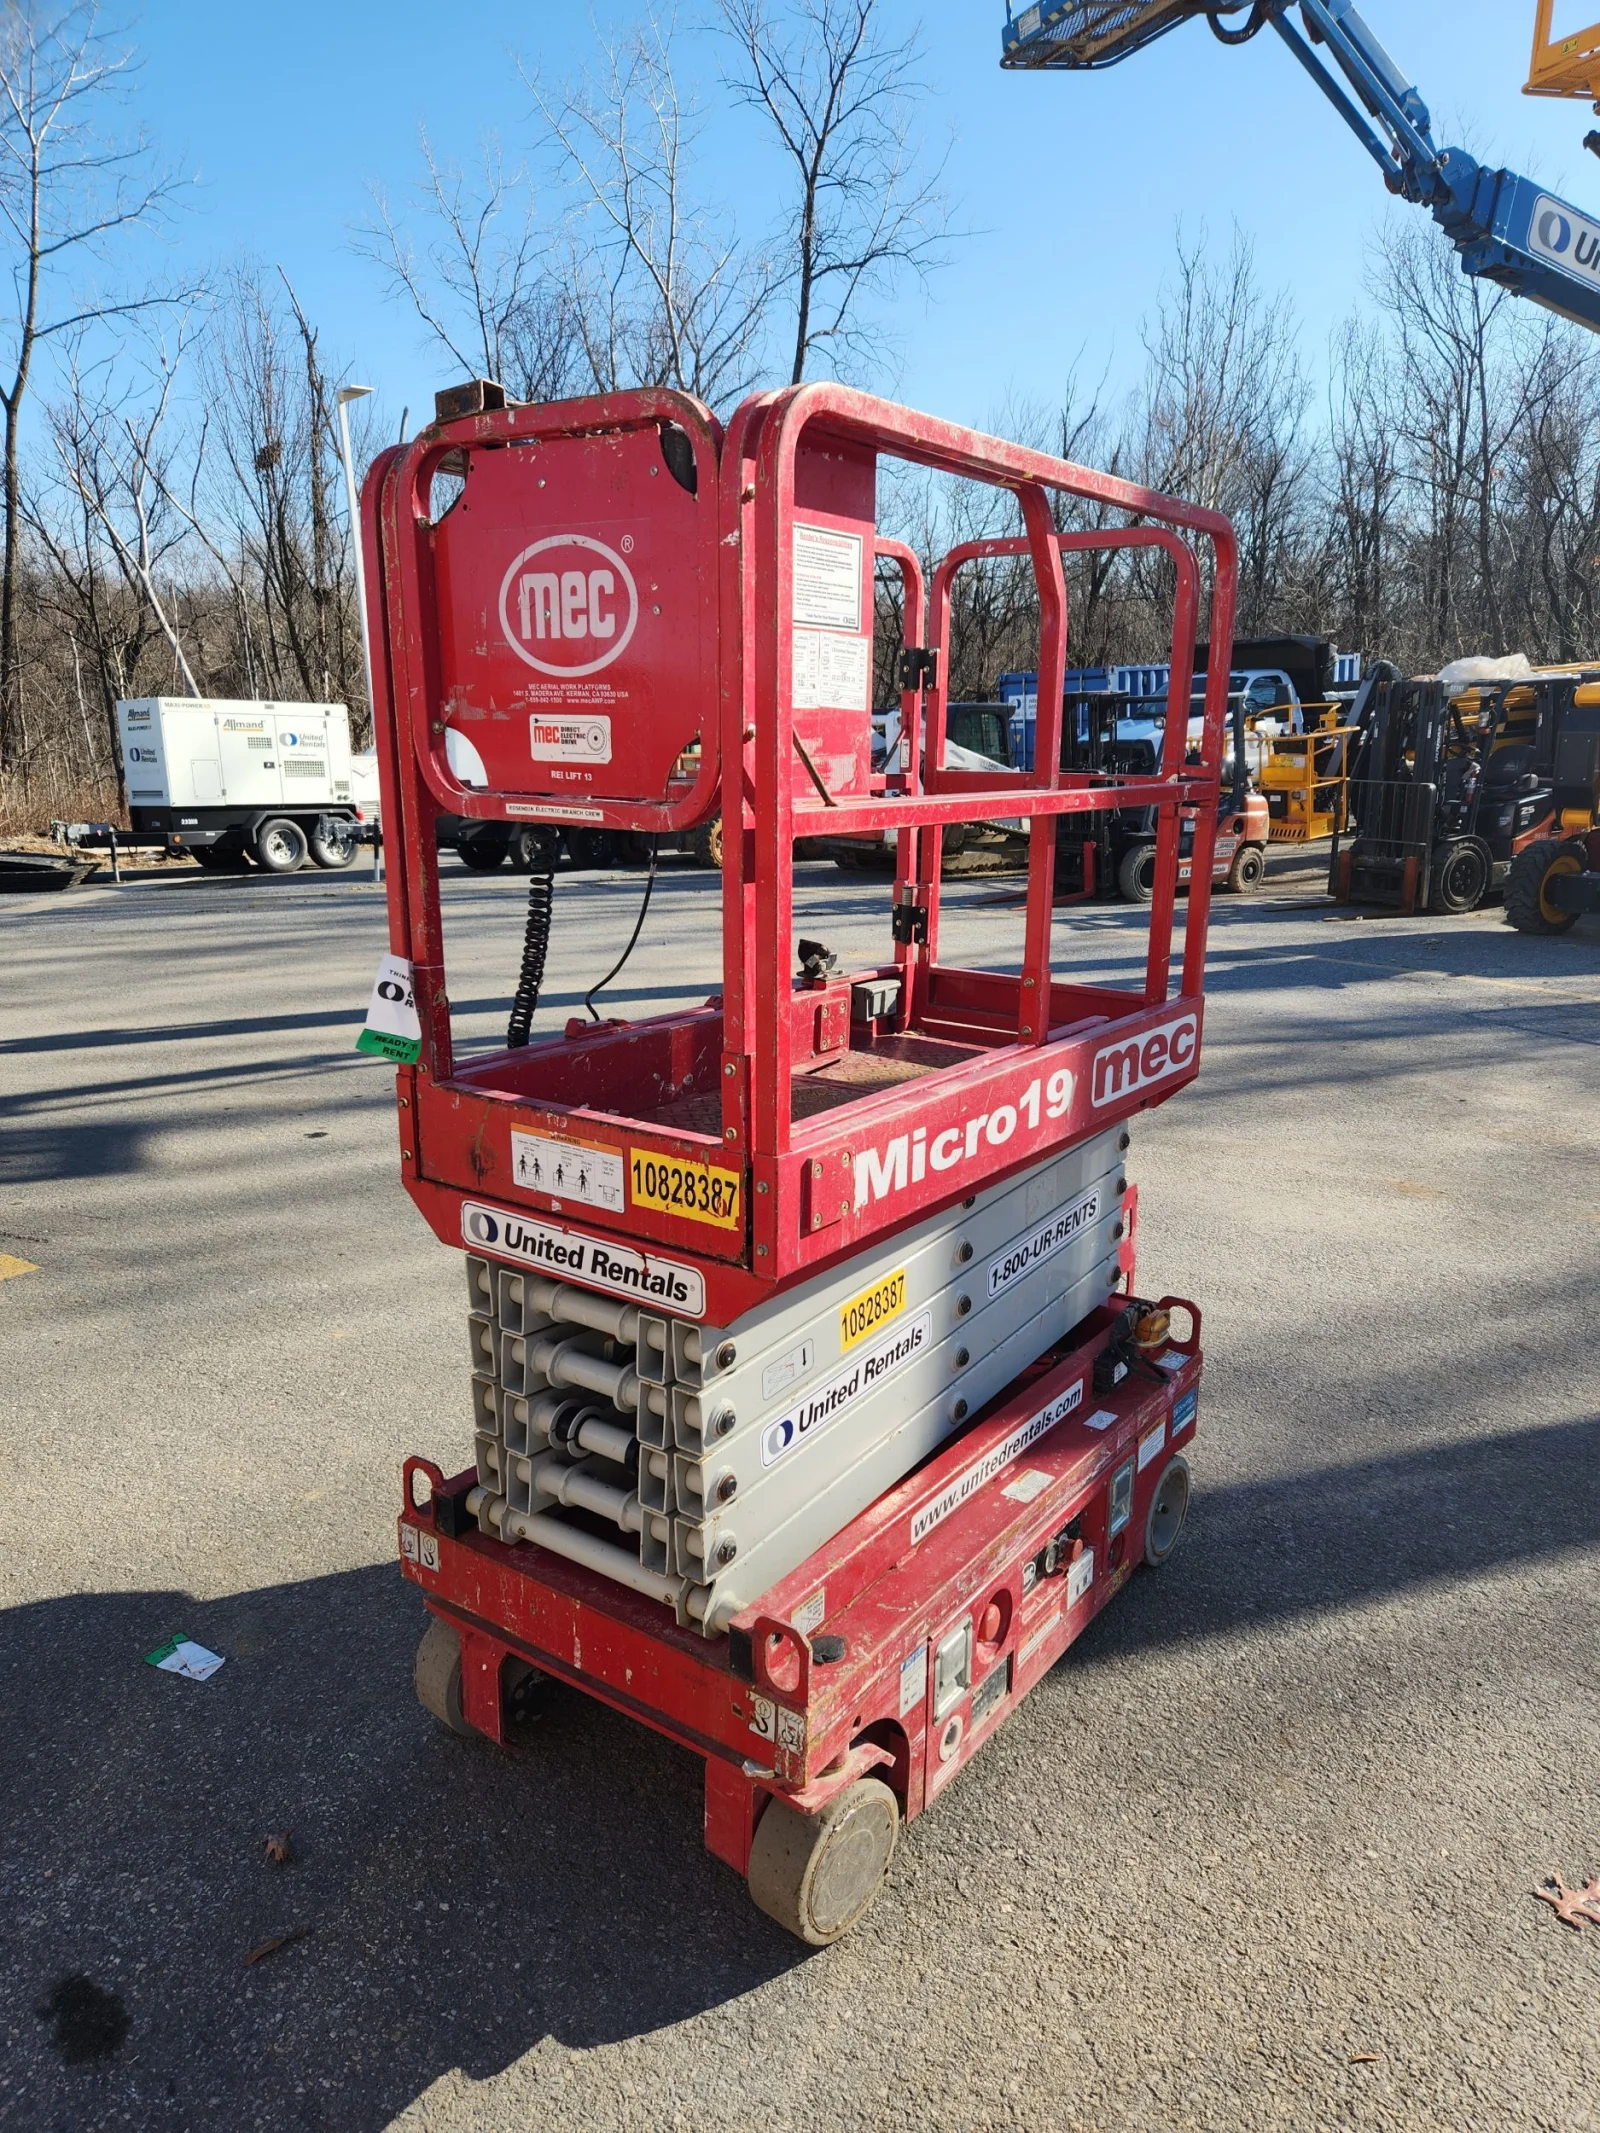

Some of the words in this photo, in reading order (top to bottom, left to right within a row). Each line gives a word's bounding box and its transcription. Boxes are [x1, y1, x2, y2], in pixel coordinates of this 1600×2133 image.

[519, 569, 615, 639] mec
[223, 719, 264, 731] Allmand
[299, 733, 323, 741] United
[534, 726, 560, 743] mec
[560, 732, 586, 740] ELECTRIC
[140, 748, 155, 756] United
[141, 755, 158, 763] Rentals
[551, 770, 564, 779] REI
[565, 771, 582, 780] LIFT
[584, 773, 593, 781] 13
[535, 806, 561, 814] ELECTRIC
[374, 1036, 409, 1048] READY
[382, 1047, 411, 1060] RENT
[1095, 1022, 1195, 1101] mec
[854, 1069, 1075, 1206] Micro19
[633, 1159, 738, 1217] 10828387
[991, 1197, 1097, 1289] 1-800-UR-RENTS
[504, 1222, 585, 1270] United
[591, 1249, 688, 1301] Rentals
[841, 1276, 905, 1342] 10828387
[798, 1370, 860, 1432] United
[864, 1328, 922, 1385] Rentals
[914, 1388, 1081, 1538] www.unitedrentals.com
